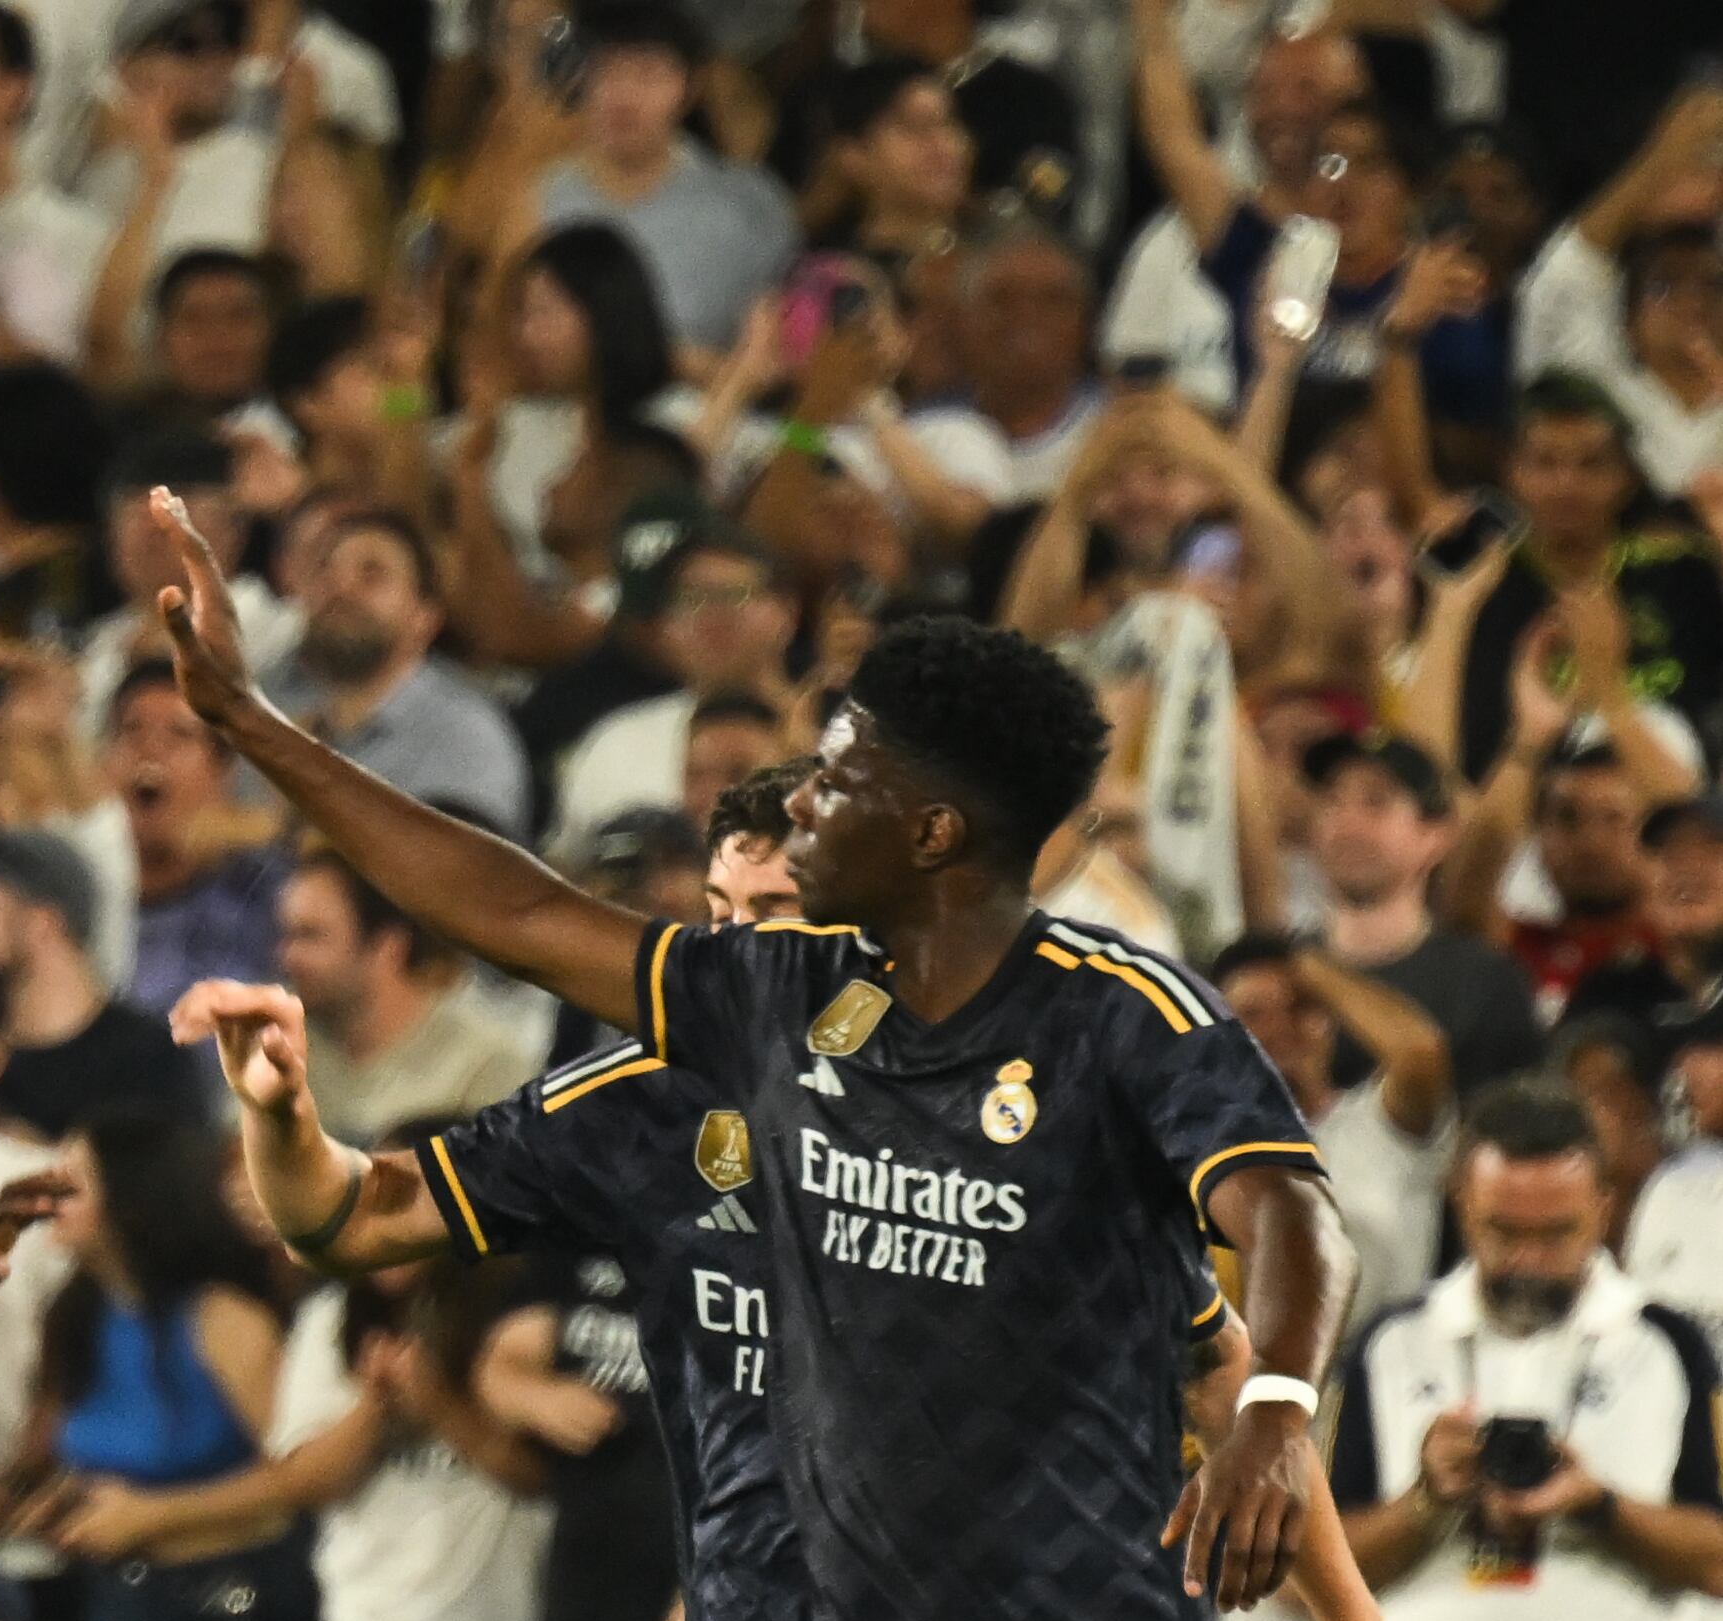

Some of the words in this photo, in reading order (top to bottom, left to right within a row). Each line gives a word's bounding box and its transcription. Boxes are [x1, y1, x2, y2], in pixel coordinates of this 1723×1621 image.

[800, 1127, 1026, 1232] Emirates
[823, 1209, 870, 1263] FLY
[868, 1221, 988, 1286] BETTER
[734, 1345, 766, 1397] FL
